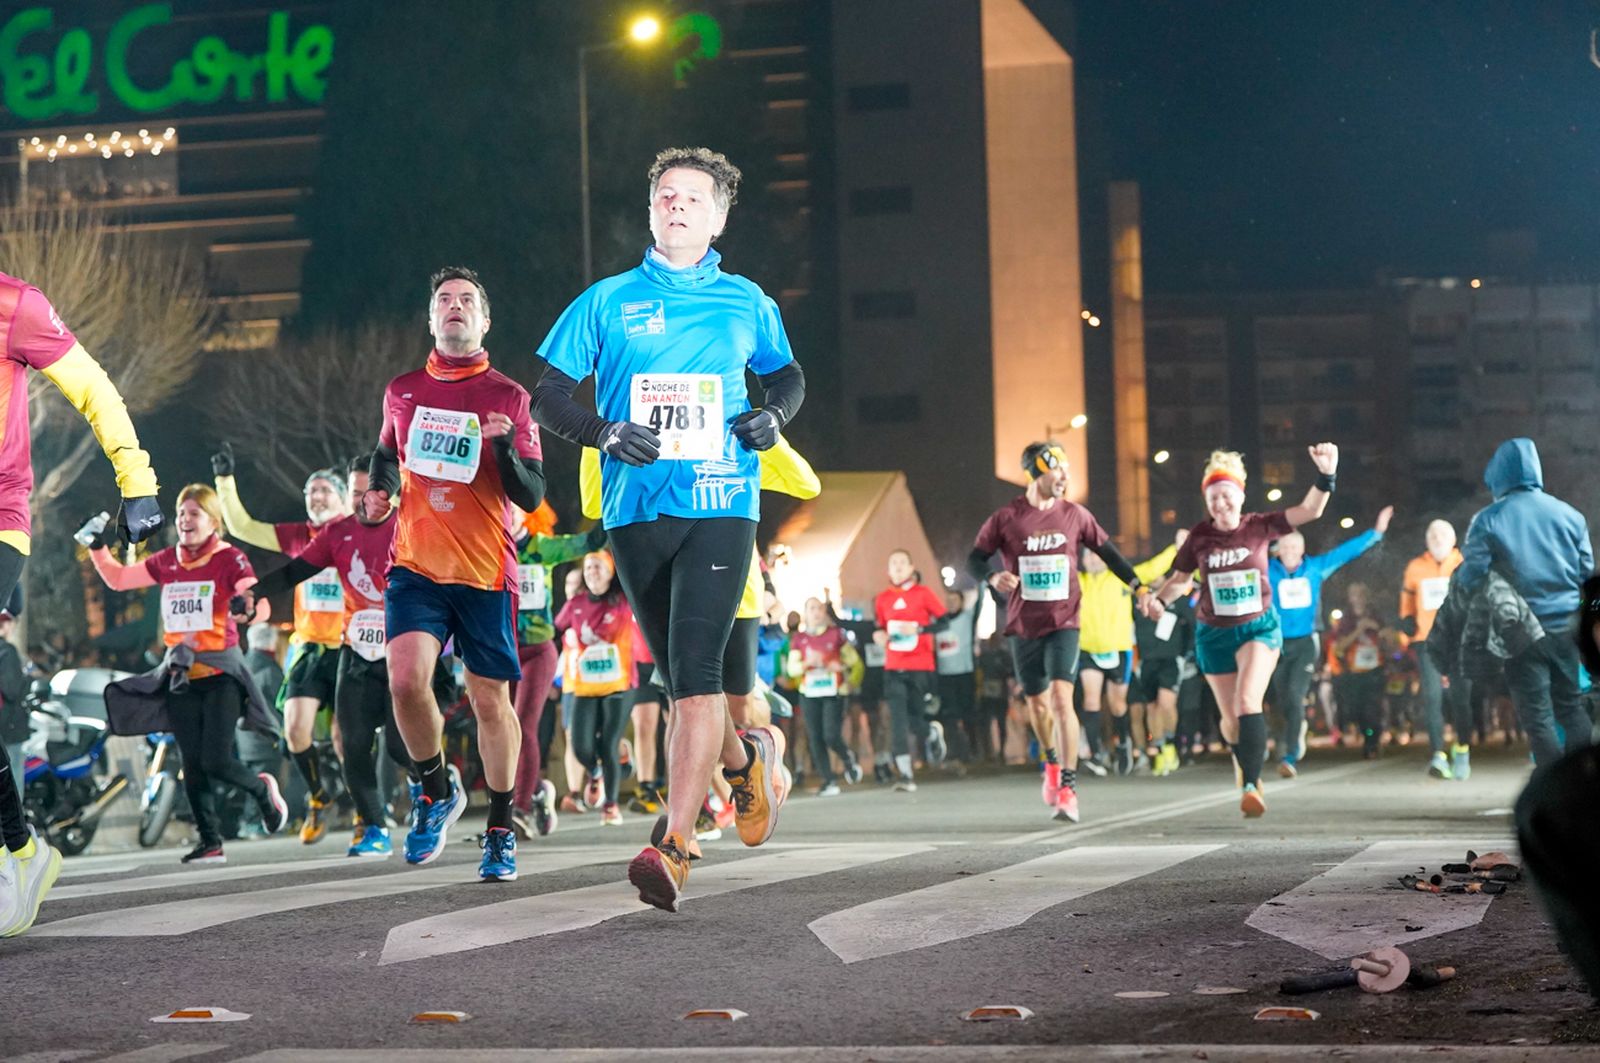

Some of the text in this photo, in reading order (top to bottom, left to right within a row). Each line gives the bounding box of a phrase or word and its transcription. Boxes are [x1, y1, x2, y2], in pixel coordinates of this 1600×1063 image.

[105, 3, 335, 112] Corte
[651, 383, 690, 392] NOCHE DE
[640, 394, 658, 403] SAN
[431, 416, 460, 426] NOCHE DE
[649, 405, 705, 430] 4788
[420, 422, 433, 430] SAN
[421, 432, 471, 458] 8206
[1025, 533, 1067, 551] WILD
[1207, 547, 1250, 569] WILD
[1029, 572, 1061, 586] 13317
[519, 581, 535, 594] 61
[1218, 585, 1255, 601] 13583
[171, 599, 203, 615] 2804
[357, 628, 384, 644] 280
